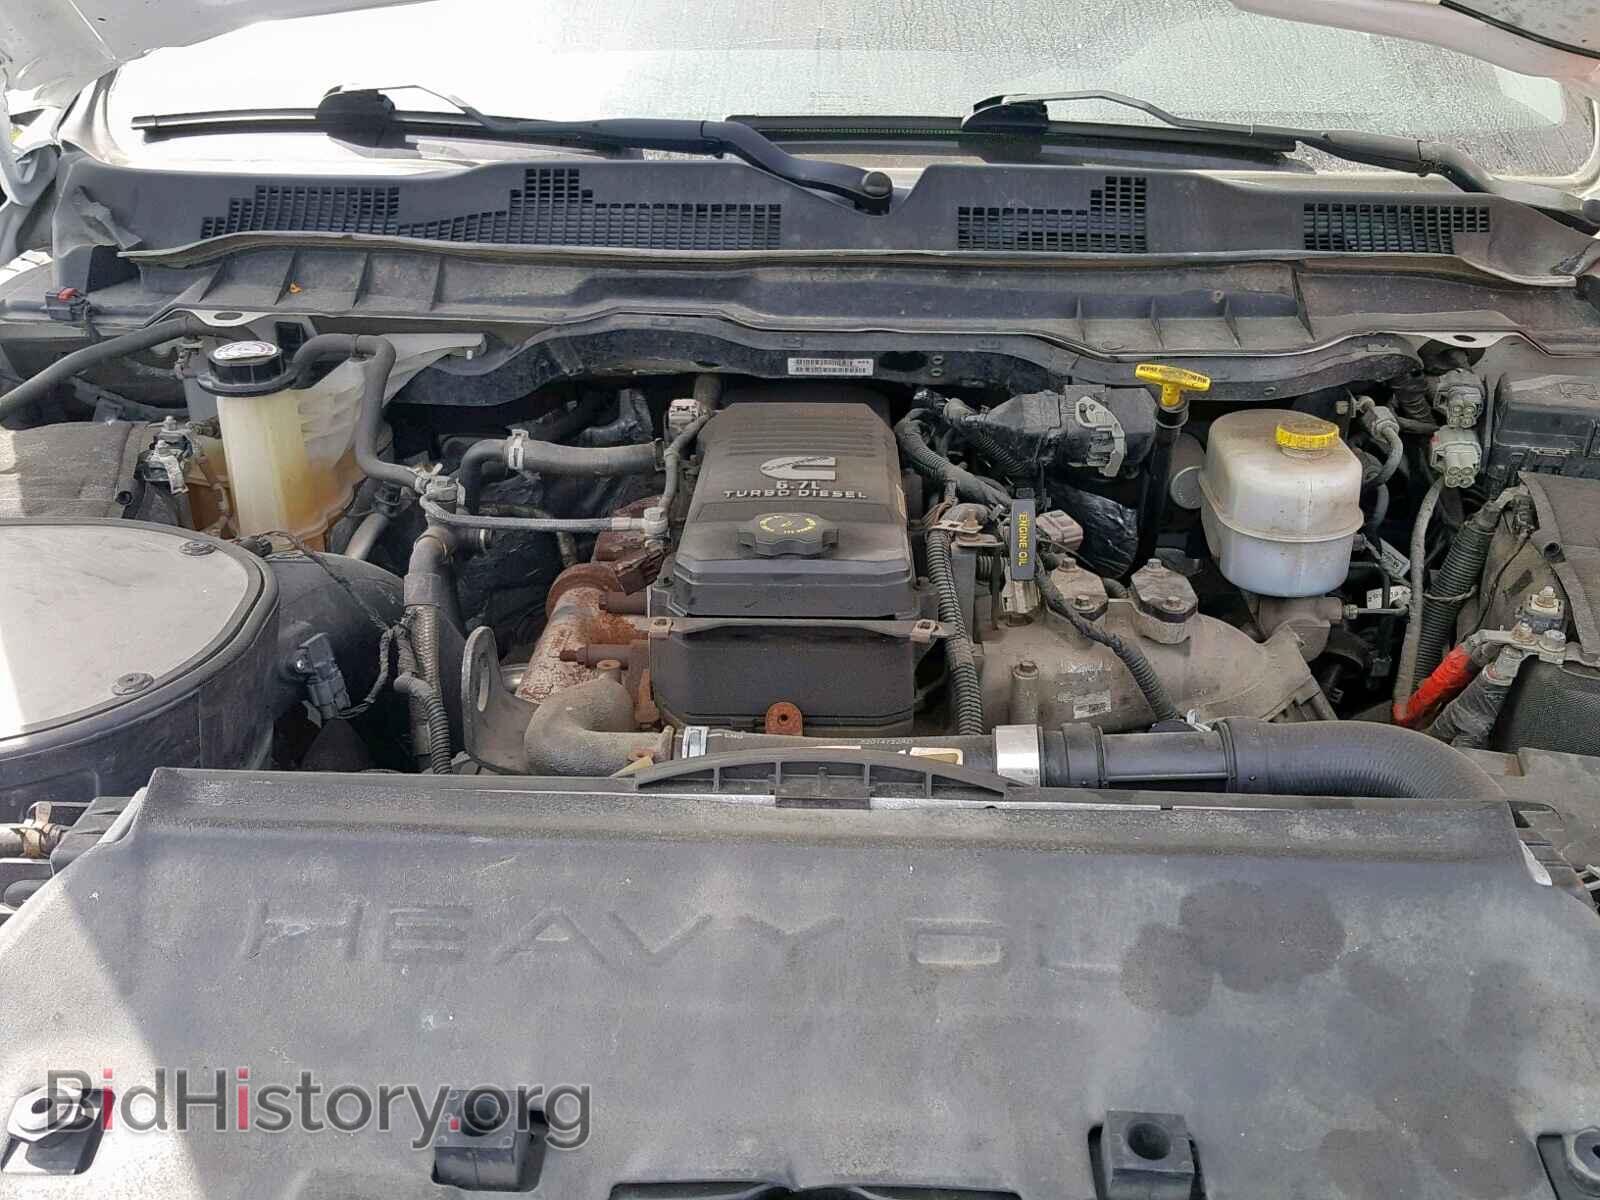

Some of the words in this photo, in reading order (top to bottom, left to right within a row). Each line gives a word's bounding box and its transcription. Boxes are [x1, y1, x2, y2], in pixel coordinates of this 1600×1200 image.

[775, 480, 821, 490] 6.7L
[722, 489, 791, 498] TURBO
[798, 489, 868, 499] DIESEL
[1018, 511, 1029, 550] ENGINE
[1018, 551, 1029, 568] OIL
